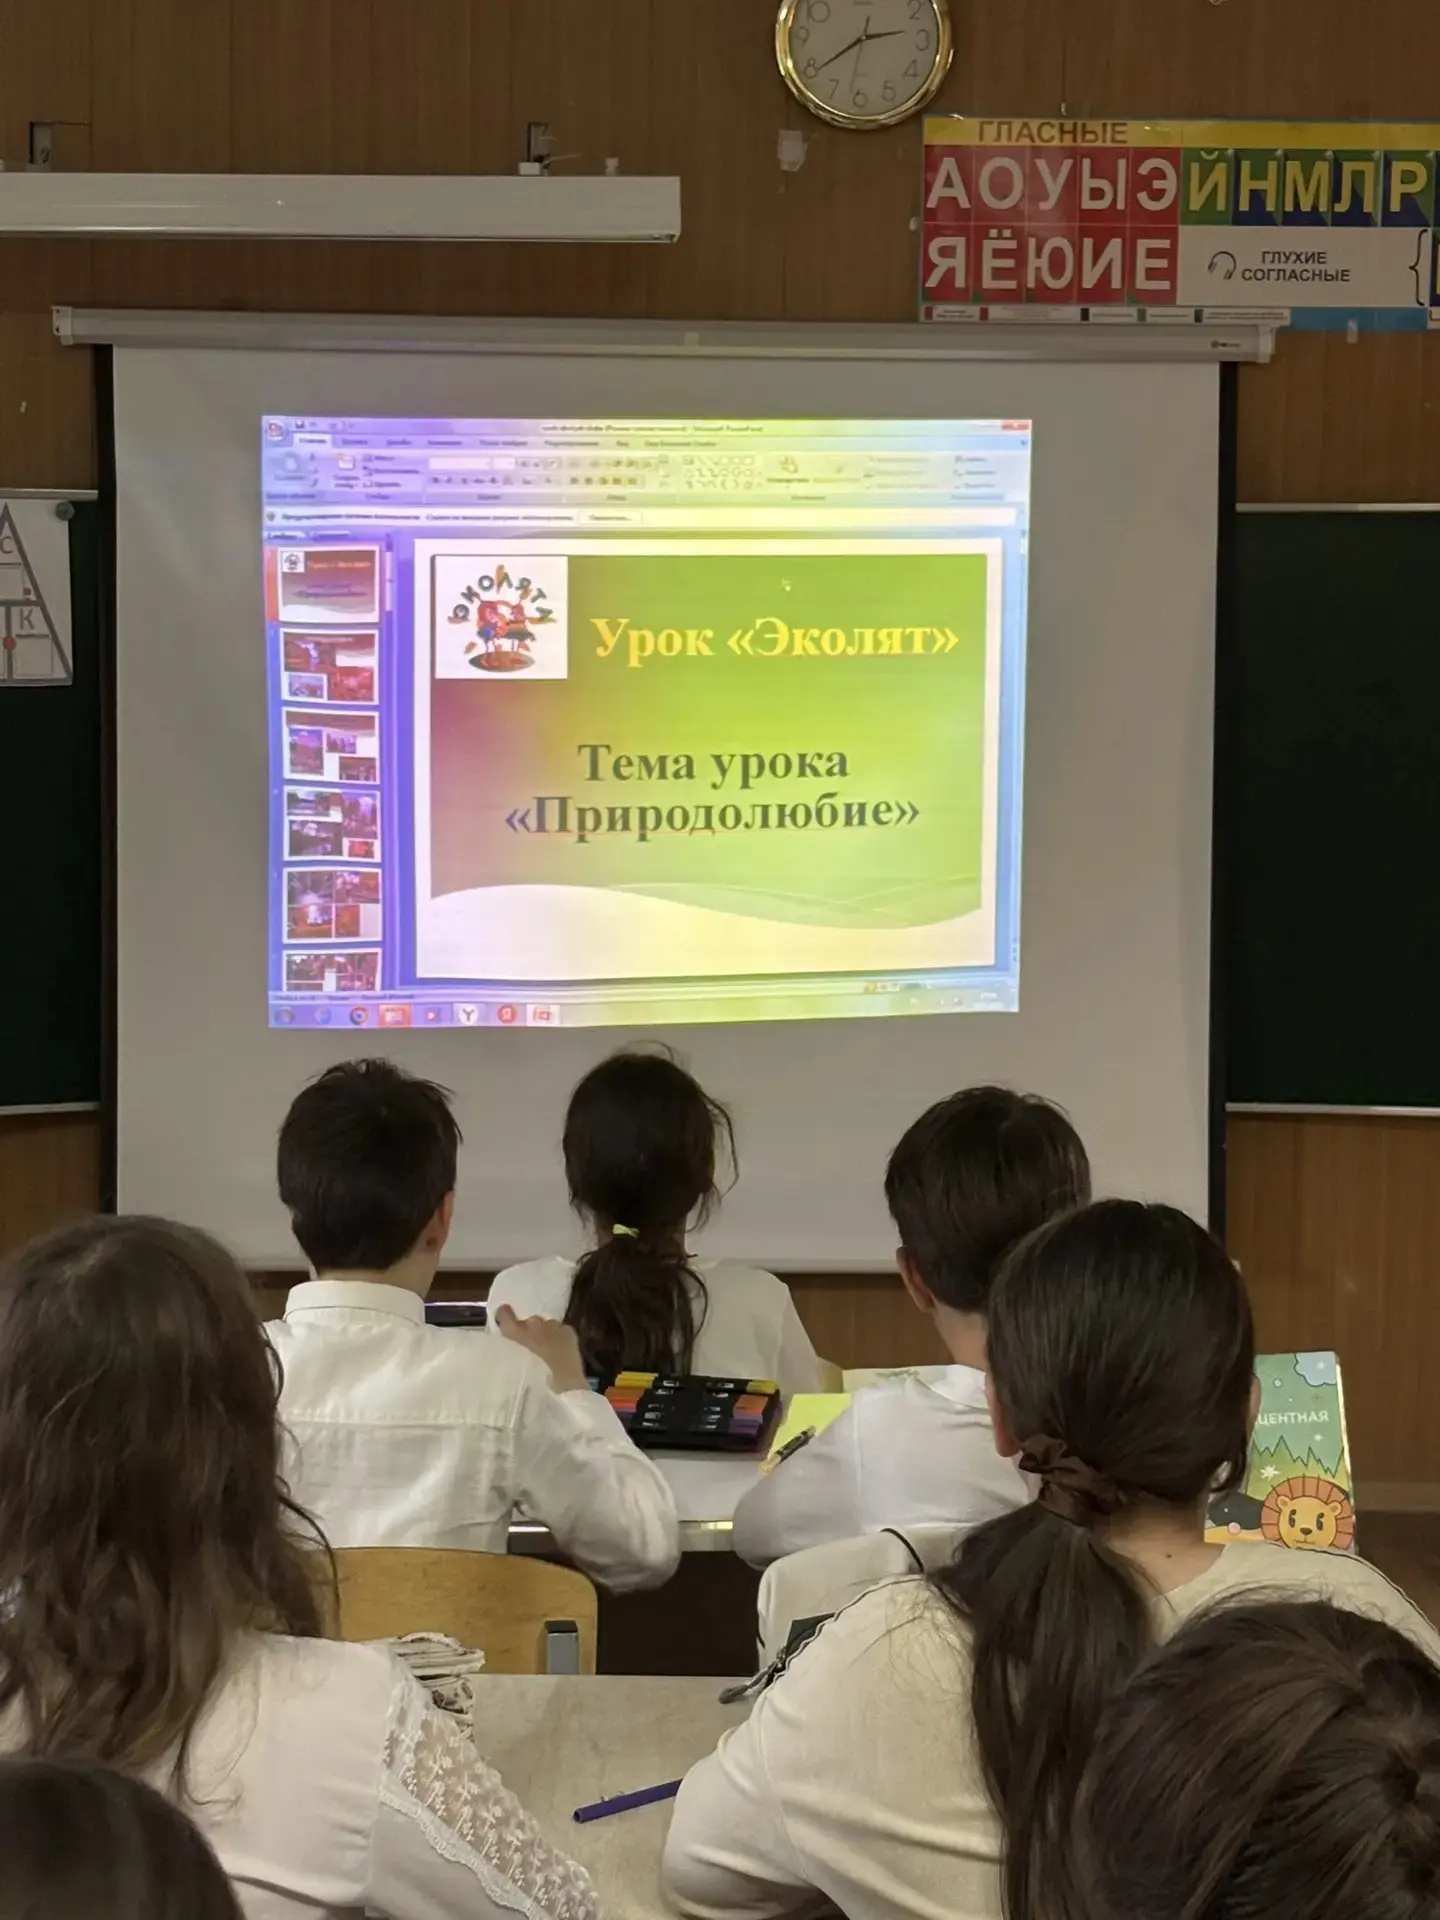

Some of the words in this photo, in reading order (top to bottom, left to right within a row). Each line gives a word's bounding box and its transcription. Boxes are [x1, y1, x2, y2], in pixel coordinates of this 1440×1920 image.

[978, 120, 1128, 144] ГЛАСНЫЕ
[1261, 250, 1328, 265] ГЛУХИЕ
[1241, 268, 1351, 283] СОГЛАСНЫЕ
[590, 617, 715, 668] Урок
[726, 616, 960, 656] «Эколят»
[577, 744, 695, 782] Тема
[710, 748, 850, 790] урока
[504, 792, 921, 844] «Природолюбие»
[1254, 1410, 1329, 1427] ЦЕНТНАЯ
